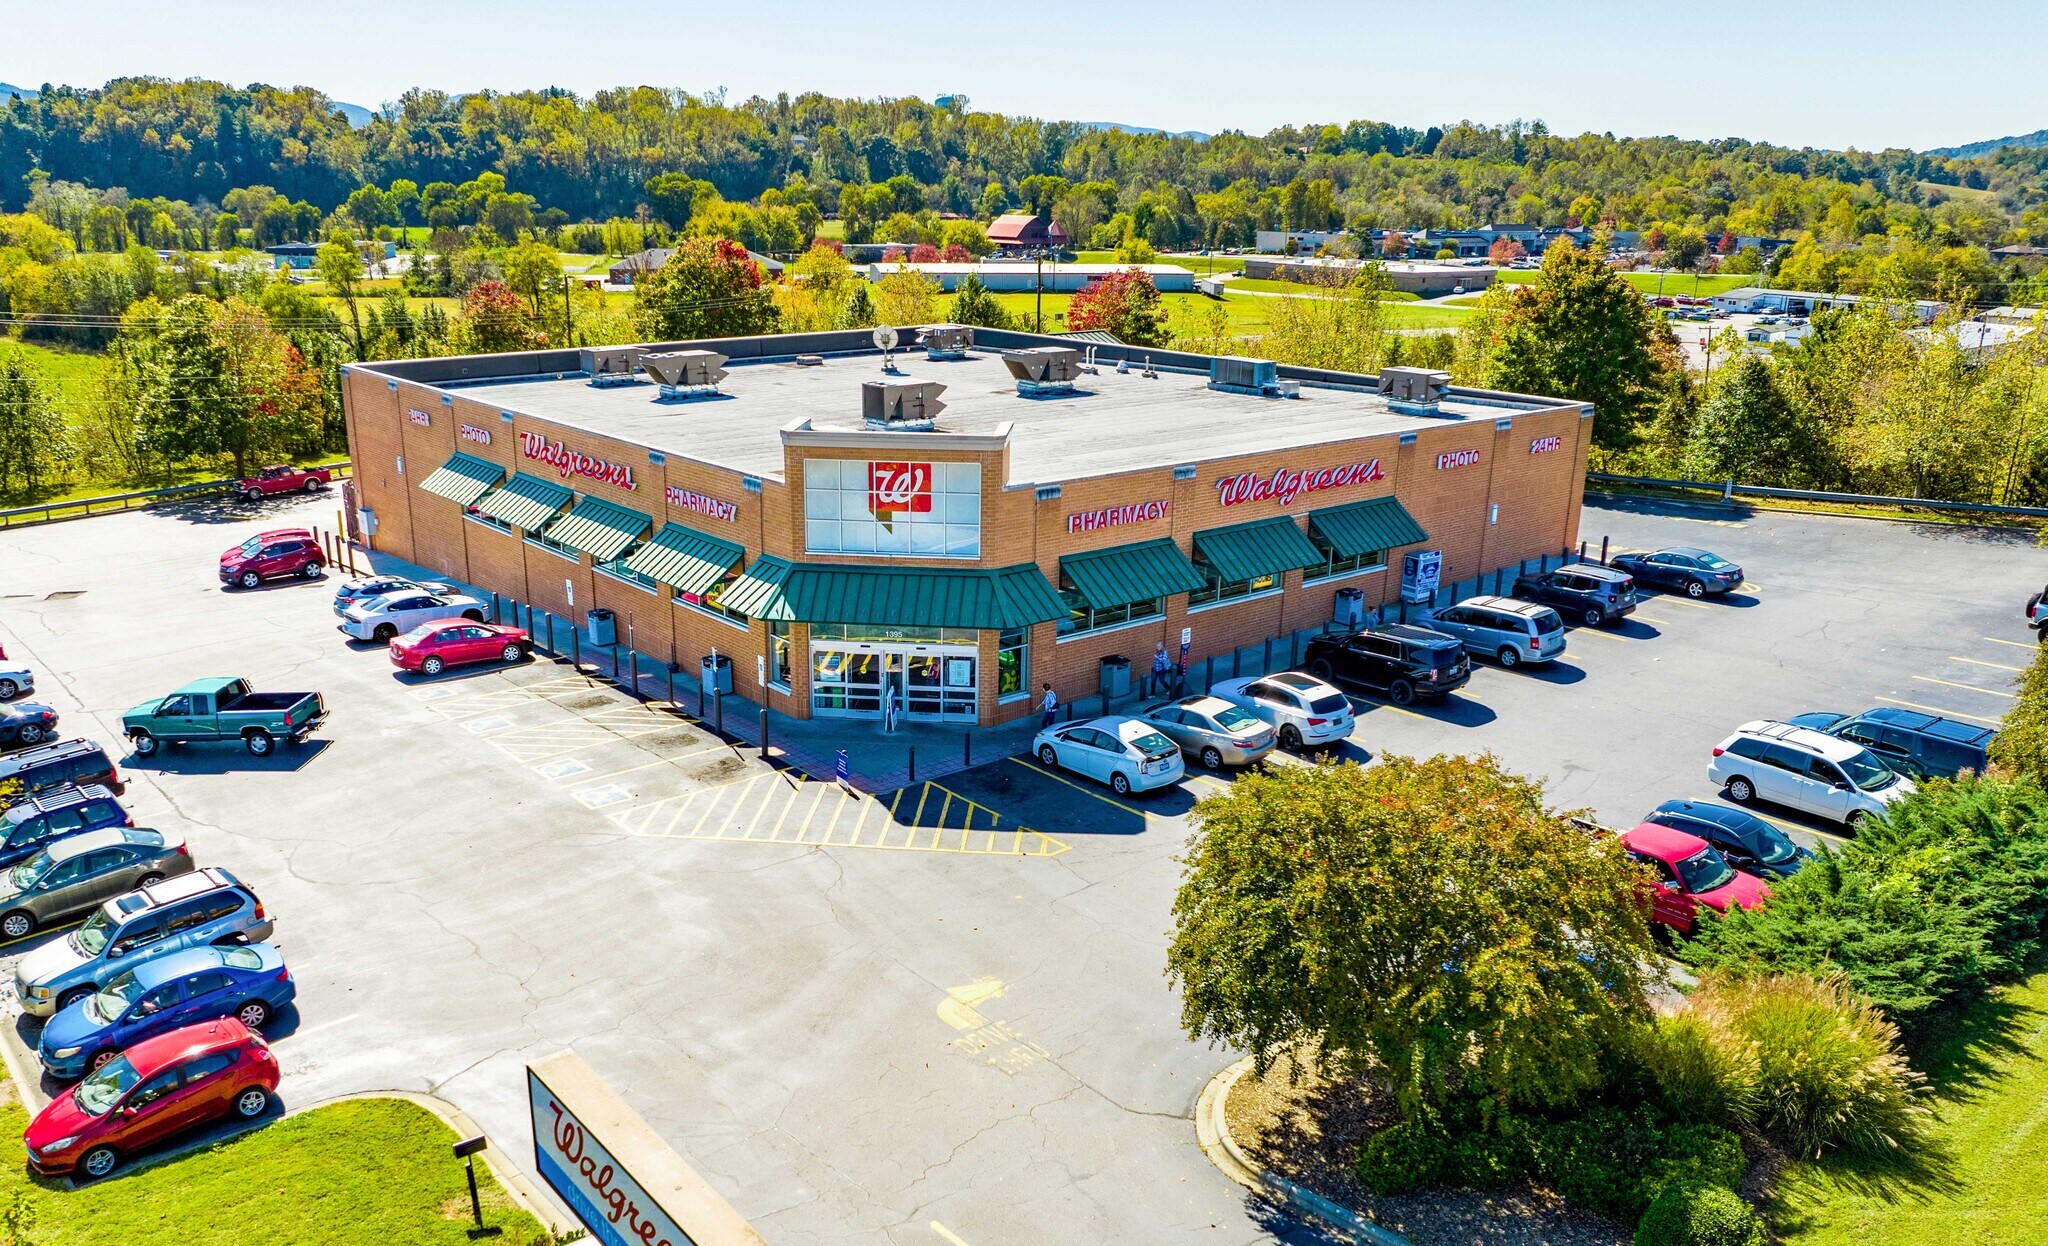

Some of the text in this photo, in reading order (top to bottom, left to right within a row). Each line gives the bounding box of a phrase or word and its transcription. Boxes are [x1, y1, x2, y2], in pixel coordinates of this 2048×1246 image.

[461, 424, 491, 445] PHOTO
[1530, 436, 1562, 454] 24HR
[520, 431, 637, 490] Walgreens
[1437, 449, 1480, 470] PHOTO
[1216, 458, 1386, 506] Walgreens
[665, 485, 737, 522] PHARMACY
[1068, 500, 1169, 534] PHARMACY
[885, 630, 903, 638] 1395
